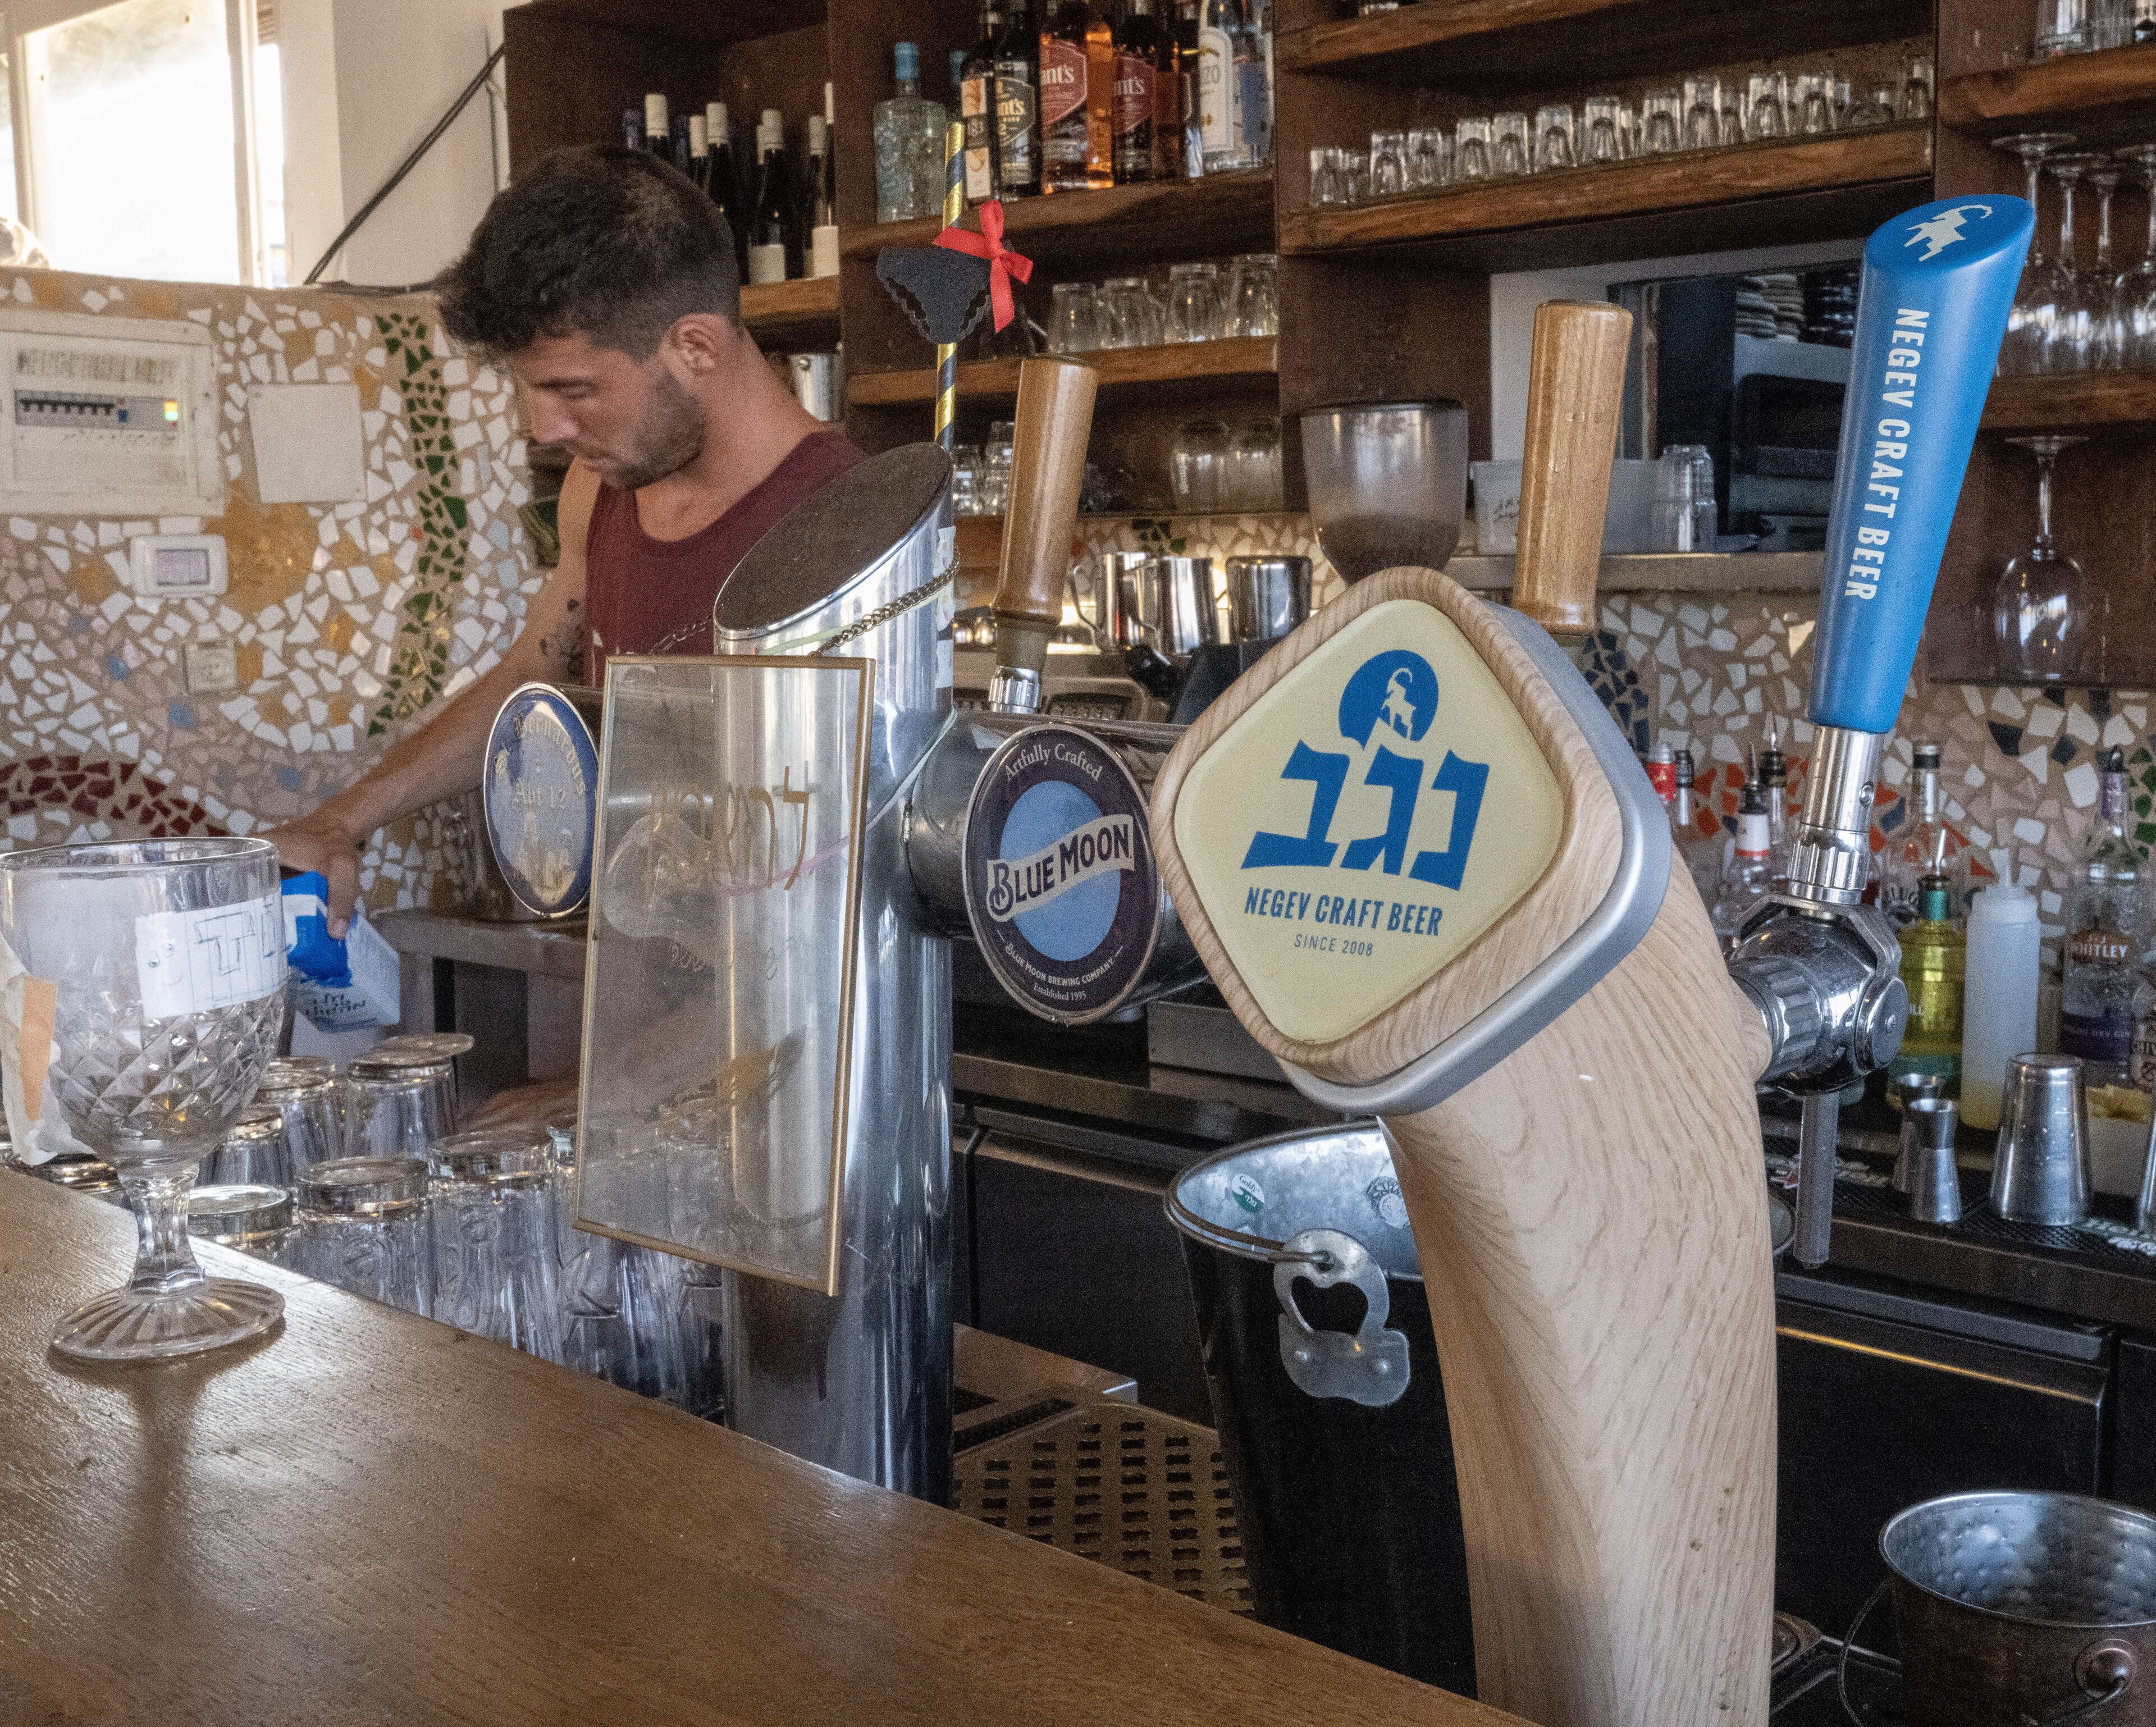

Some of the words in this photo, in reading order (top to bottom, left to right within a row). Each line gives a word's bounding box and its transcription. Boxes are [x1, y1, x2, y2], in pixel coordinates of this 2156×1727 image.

[1883, 308, 1929, 408] NEGEV
[1863, 418, 1911, 519] CRAFT
[1844, 527, 1889, 600] BEER
[1005, 743, 1051, 782] Artfully
[1054, 743, 1103, 782] Crafted
[1240, 739, 1490, 891] נגב
[989, 853, 1056, 916] BLUE
[1059, 824, 1130, 883] MOON
[1244, 886, 1311, 920] NEGEV
[1315, 894, 1384, 929] CRAFT
[1387, 902, 1443, 936] BEER
[1005, 942, 1025, 967] BLUE
[1025, 962, 1047, 981] MOON
[1048, 975, 1081, 986] BREWING
[1081, 957, 1114, 984] COMPANY
[1294, 933, 1337, 952] SINCE
[1341, 940, 1373, 957] 2008
[1034, 983, 1069, 1001] Established
[1070, 990, 1087, 1001] 1995
[1239, 1175, 1257, 1193] Goldy
